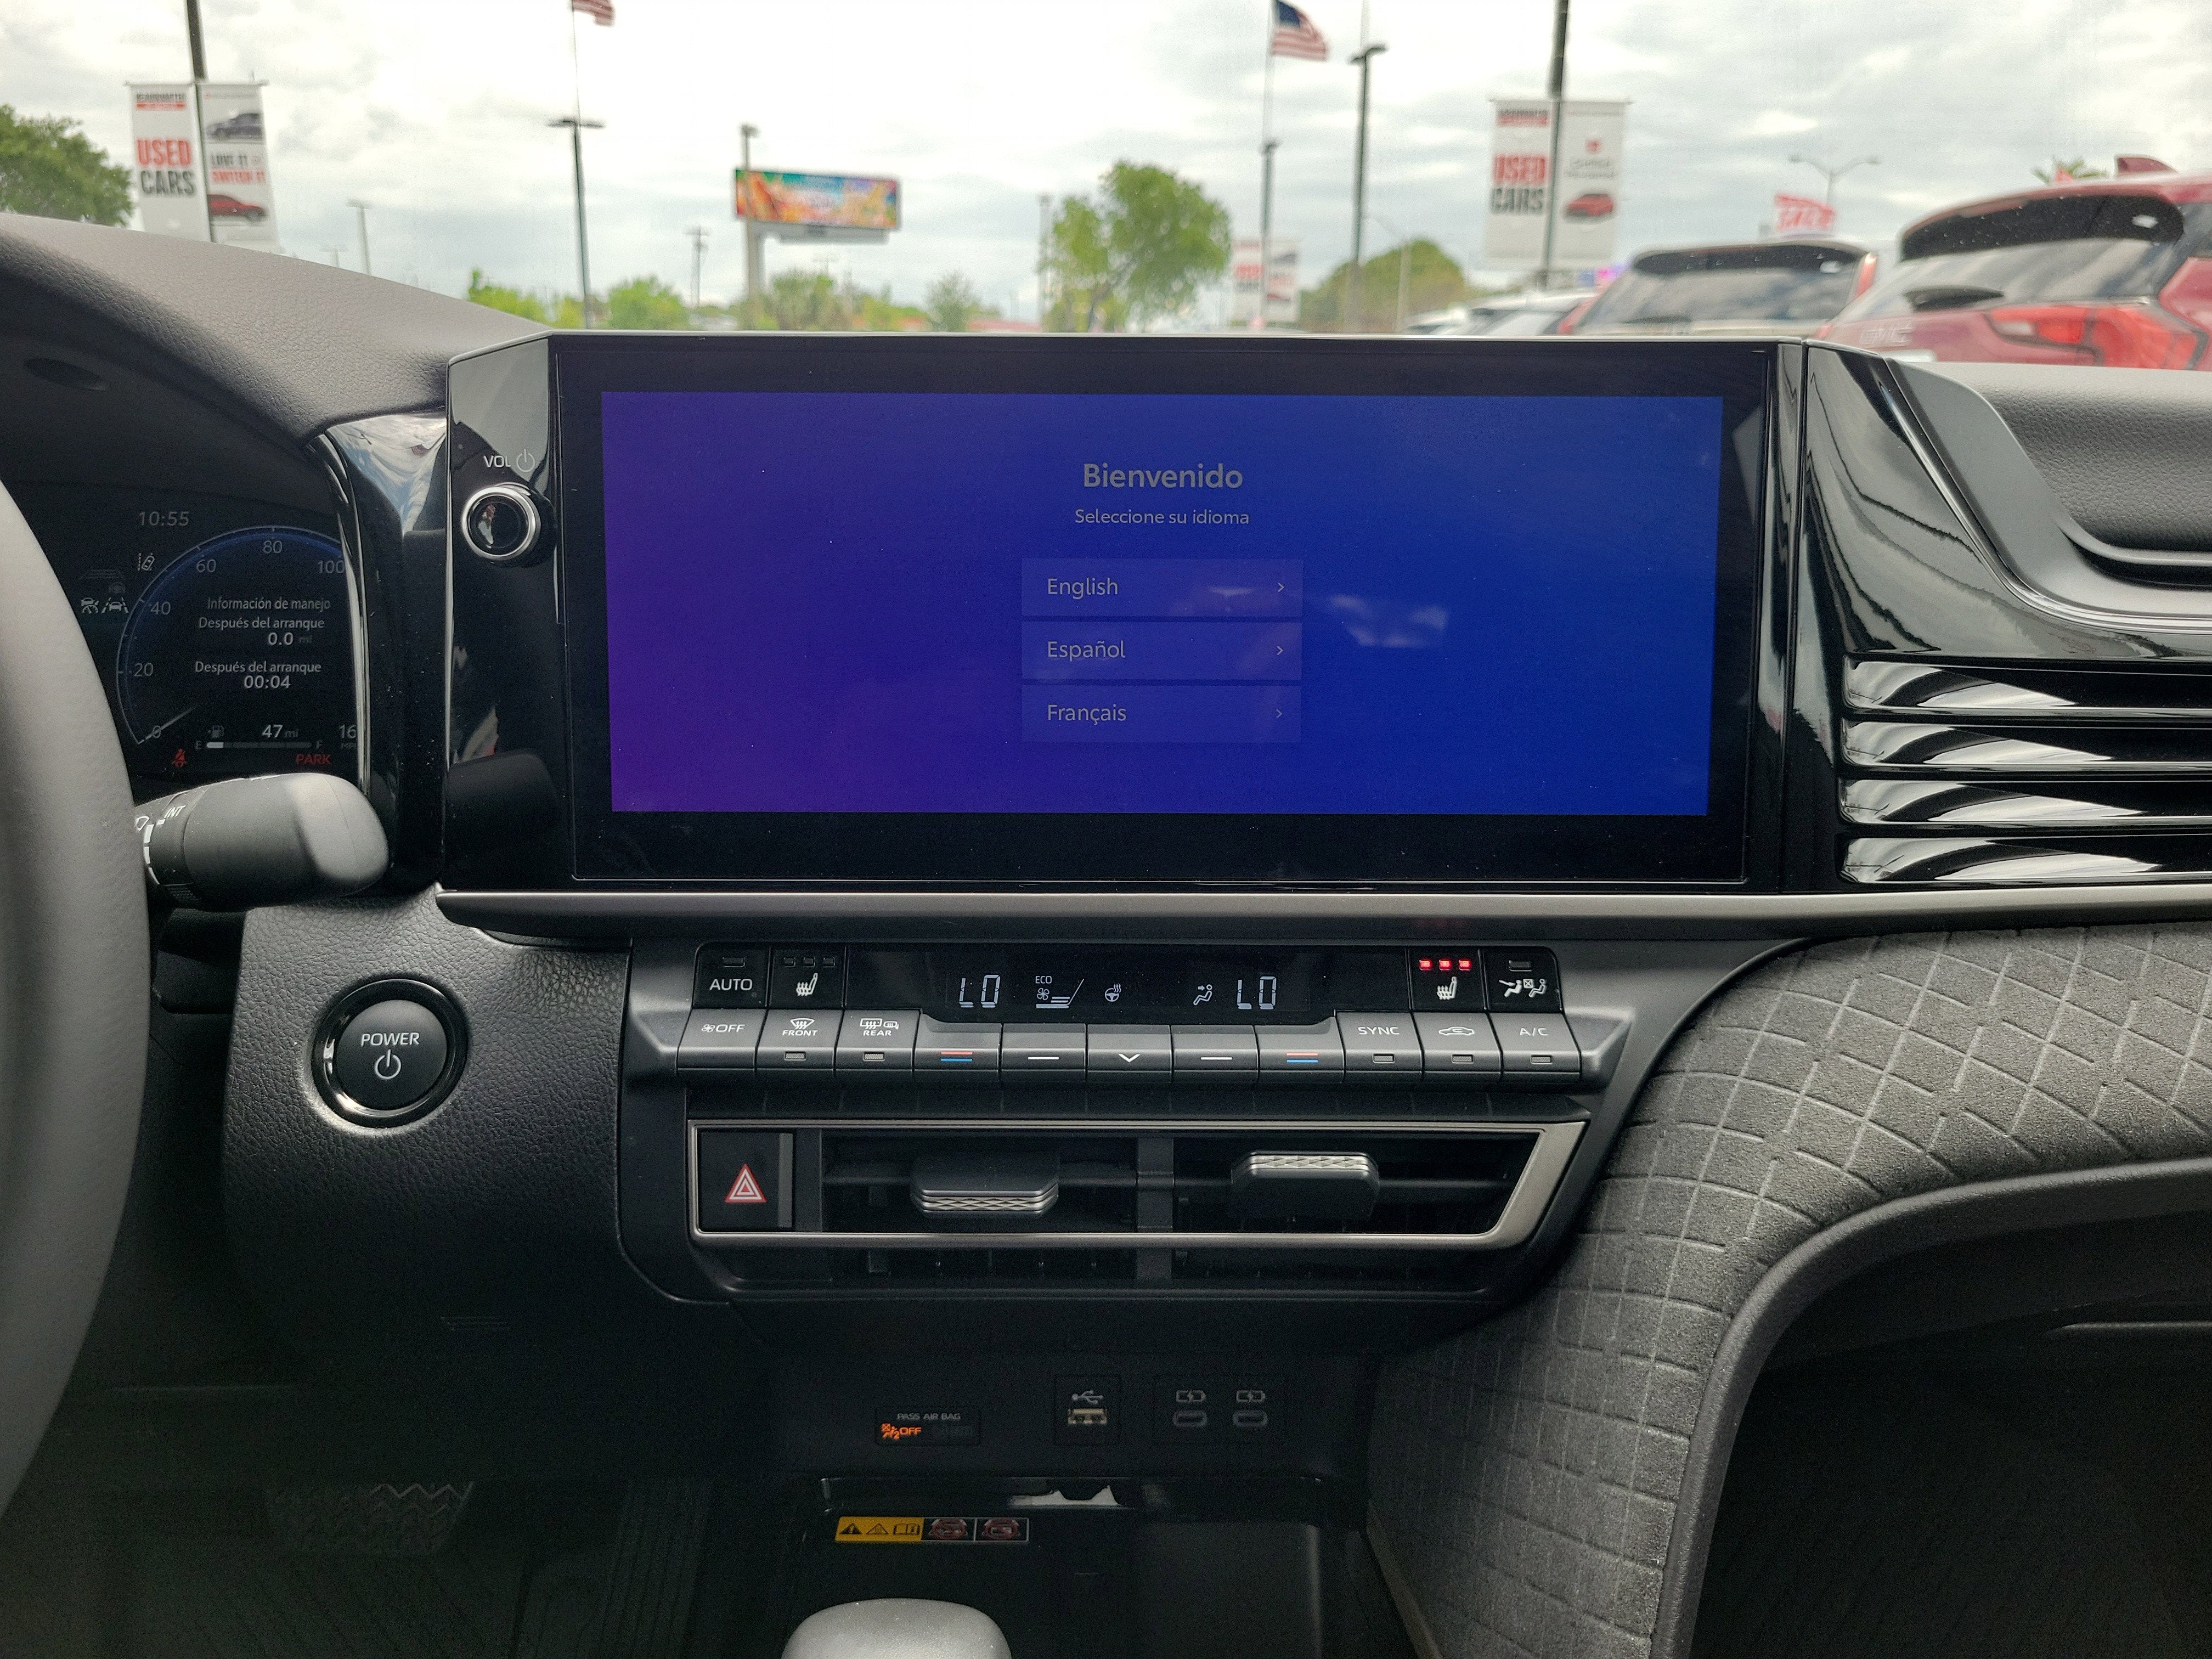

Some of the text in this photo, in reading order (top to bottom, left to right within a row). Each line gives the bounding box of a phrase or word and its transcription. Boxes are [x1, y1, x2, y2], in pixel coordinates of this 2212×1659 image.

[137, 139, 191, 166] USED
[1494, 155, 1546, 184] USED
[140, 170, 195, 194] CARS
[1491, 188, 1543, 214] CARS
[483, 455, 512, 468] VOL
[1083, 462, 1244, 489] Bienvenido
[138, 511, 190, 527] 10:55
[1074, 509, 1250, 524] Seleccione su idioma
[263, 540, 283, 554] 80
[196, 559, 217, 573] 60
[317, 560, 345, 573] 100
[1047, 577, 1119, 599] English
[150, 601, 171, 616] 40
[207, 597, 331, 613] Información de manejo
[199, 616, 325, 632] Después del arranque
[268, 633, 294, 646] 0.0
[1047, 640, 1126, 662] Español
[134, 663, 154, 678] 20
[195, 661, 321, 675] Después del arranque
[244, 675, 291, 689] 00:04
[1047, 703, 1127, 725] Français
[262, 725, 299, 738] 47 mi
[296, 753, 331, 765] PARK
[164, 805, 186, 819] INT
[709, 978, 753, 991] AUTO
[1035, 975, 1053, 984] ECO
[716, 1023, 745, 1034] OFF
[862, 1029, 893, 1037] REAR
[1358, 1026, 1400, 1036] SYNC
[1519, 1026, 1549, 1037] A/C
[361, 1032, 420, 1047] POWER
[941, 1413, 962, 1421] BAG
[899, 1426, 922, 1435] OFF
